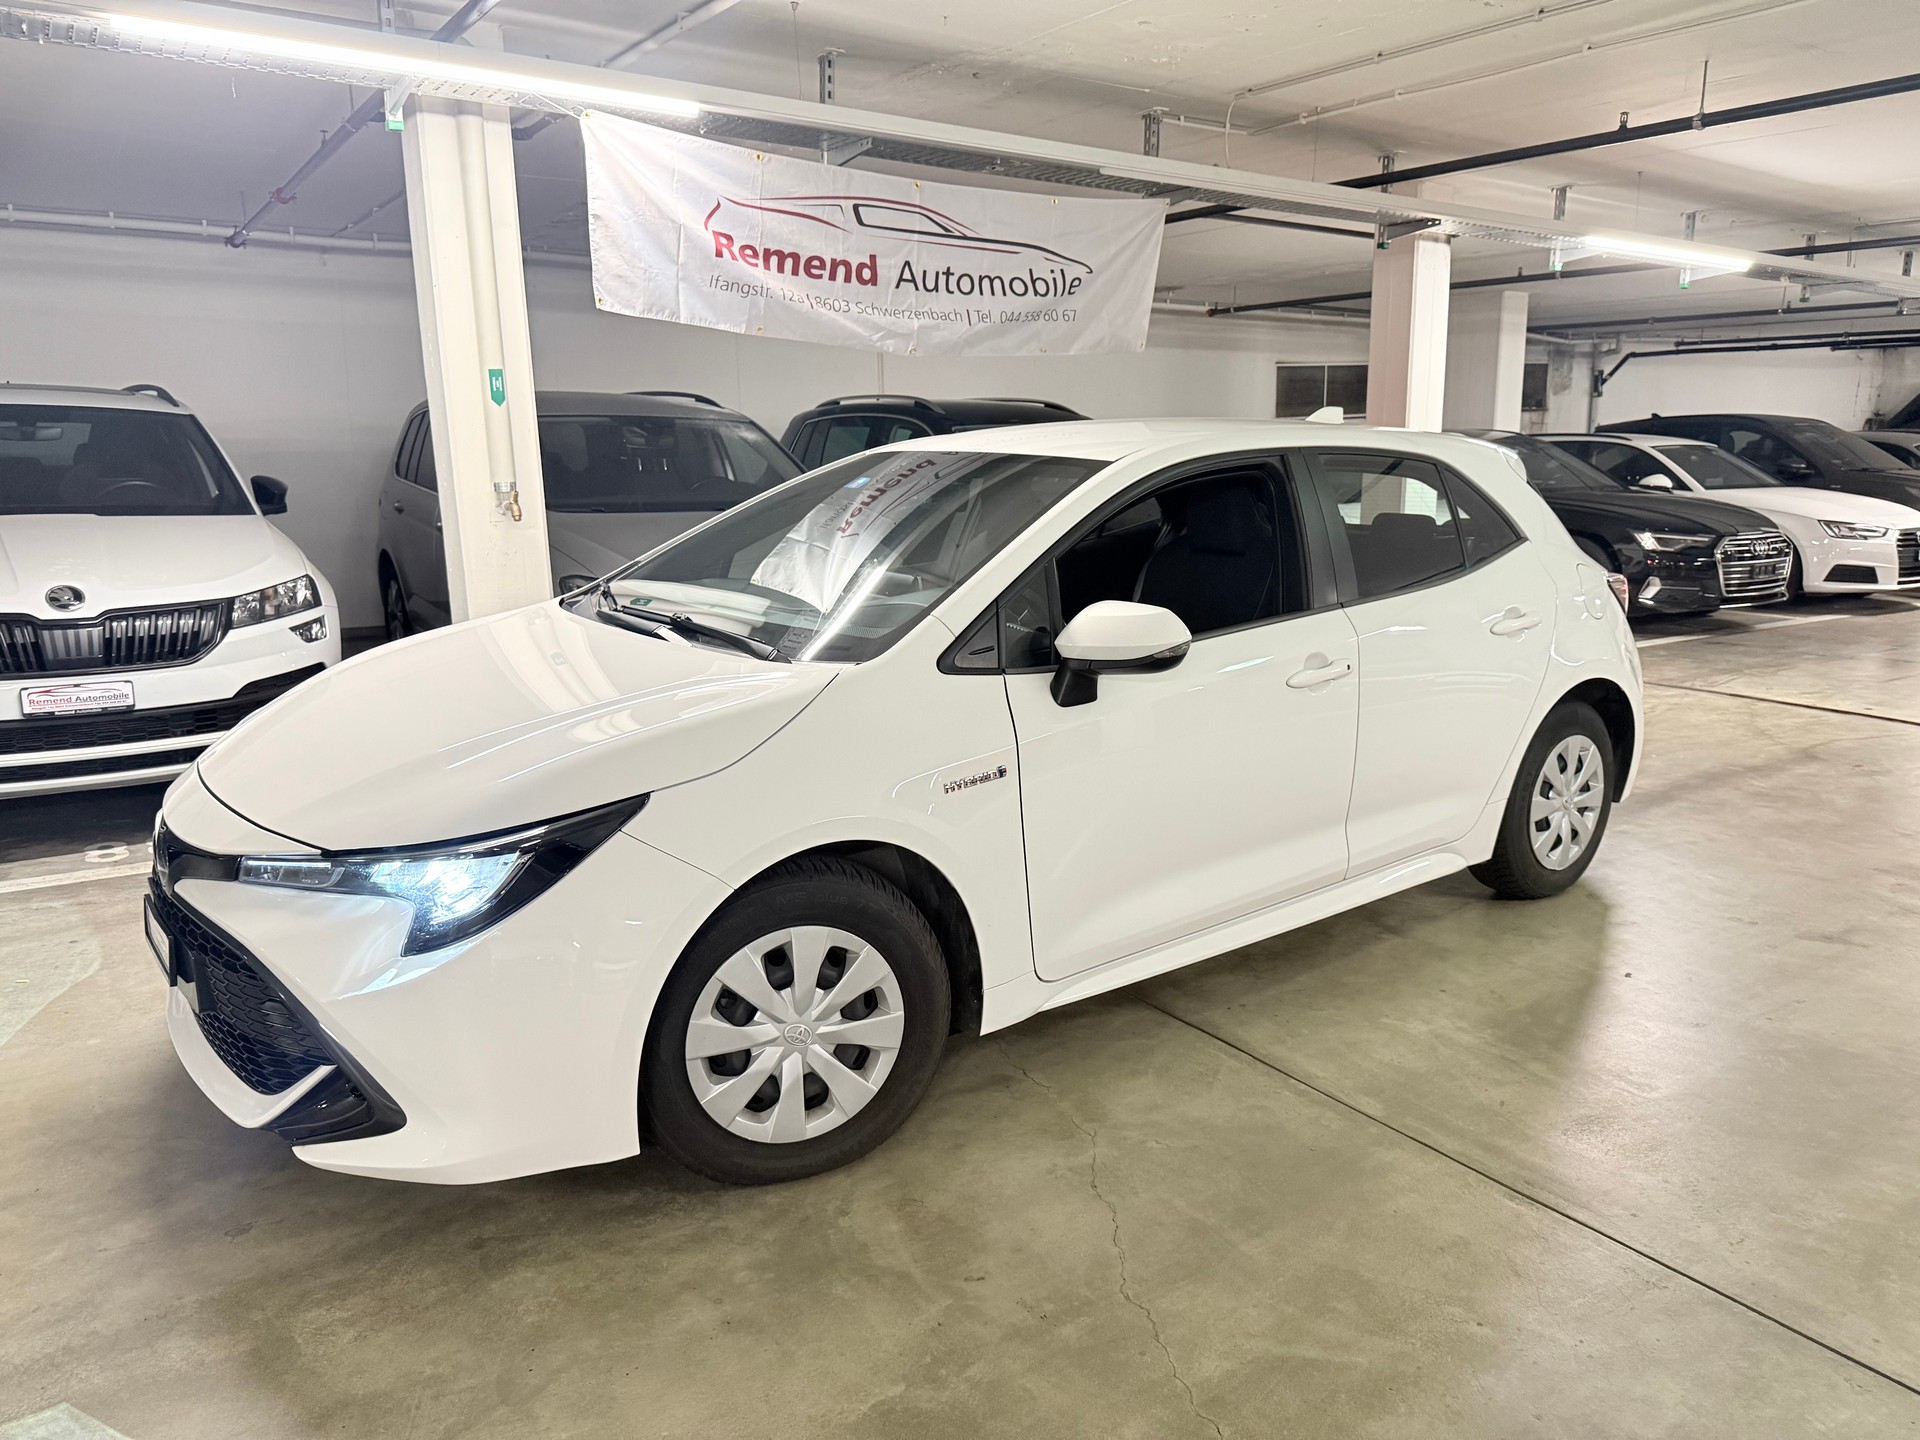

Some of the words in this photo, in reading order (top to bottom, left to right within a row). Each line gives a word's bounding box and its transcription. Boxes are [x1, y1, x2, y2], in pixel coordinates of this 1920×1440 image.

[712, 230, 878, 287] Remend
[895, 260, 1082, 298] Automobile
[709, 274, 774, 299] Ifangstr.
[814, 296, 851, 313] 8603
[855, 301, 963, 323] Schwerzenbach
[973, 309, 996, 325] Tel.
[1000, 311, 1020, 324] 044
[1021, 310, 1043, 323] 558
[1043, 308, 1059, 322] 60
[1062, 309, 1077, 322] 67
[29, 697, 73, 706] Remend
[75, 692, 130, 703] Automobile
